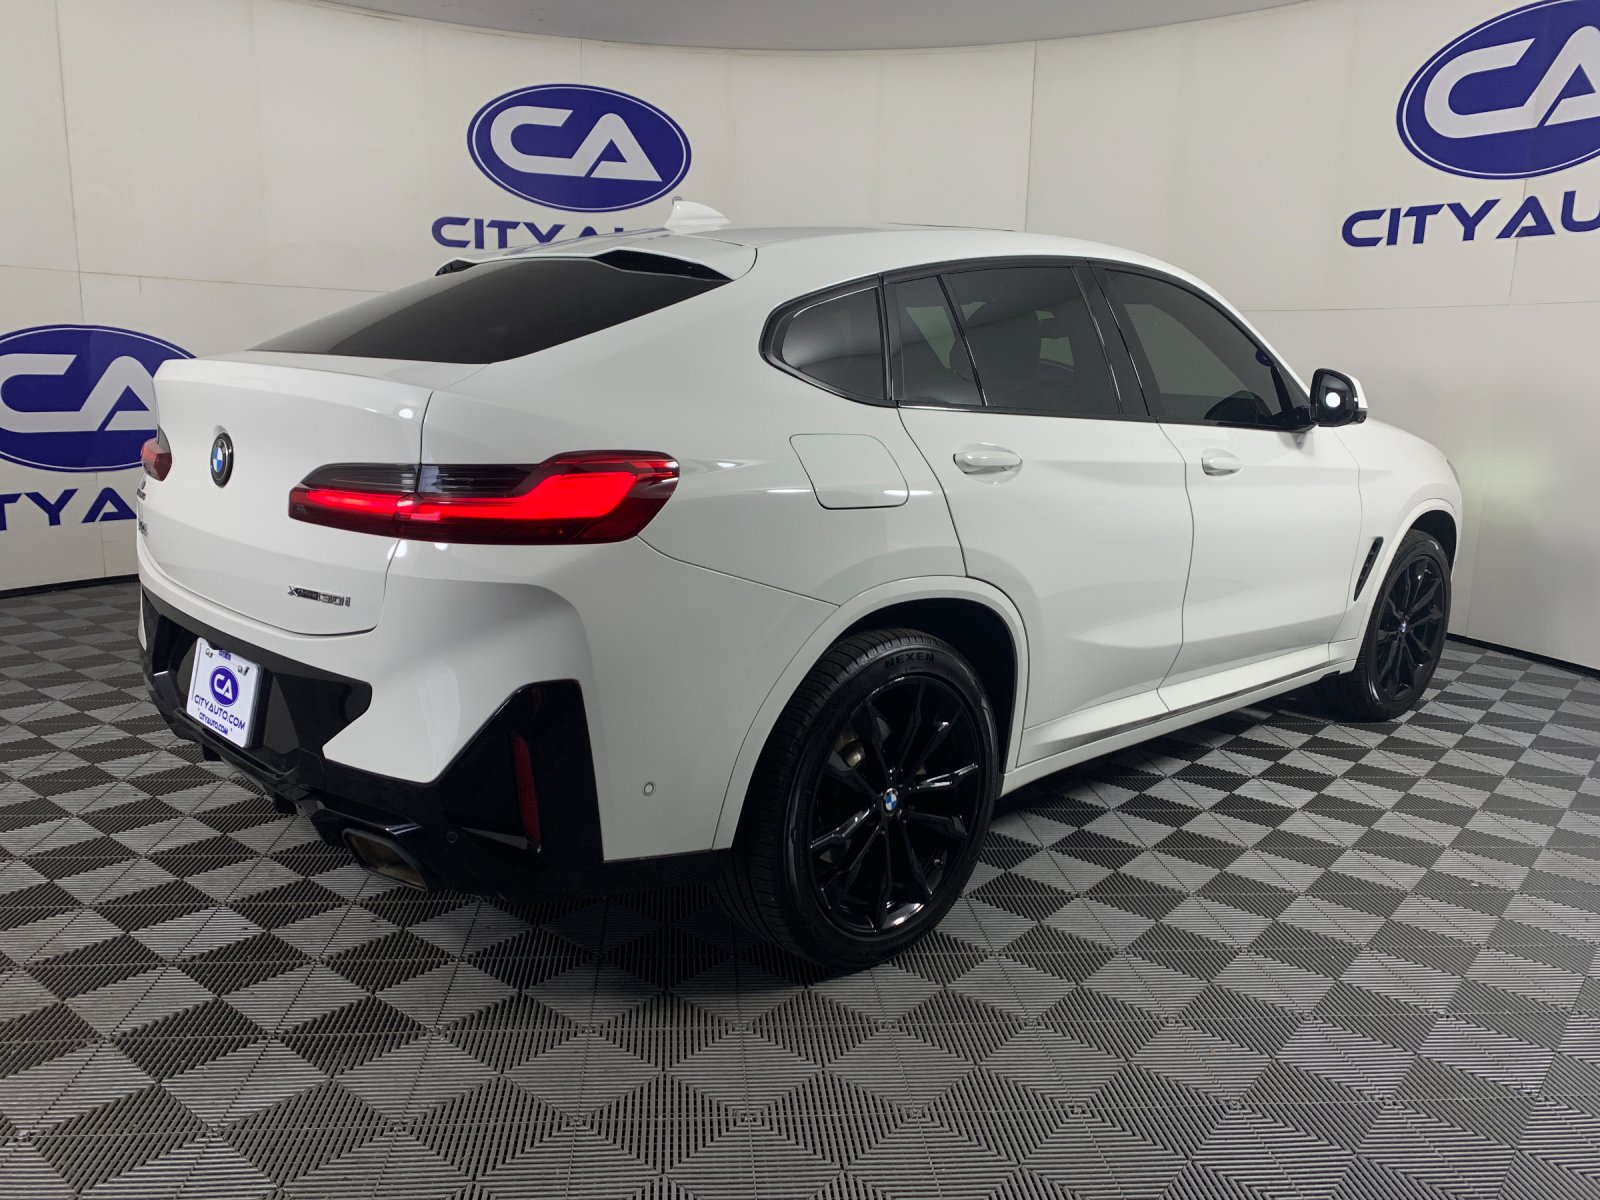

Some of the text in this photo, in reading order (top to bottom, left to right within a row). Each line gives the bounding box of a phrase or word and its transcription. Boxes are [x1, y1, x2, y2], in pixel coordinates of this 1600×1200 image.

[1424, 25, 1600, 139] CA
[490, 105, 662, 182] CA
[0, 353, 158, 434] CA
[213, 673, 233, 701] CA
[885, 652, 935, 668] NEXEN
